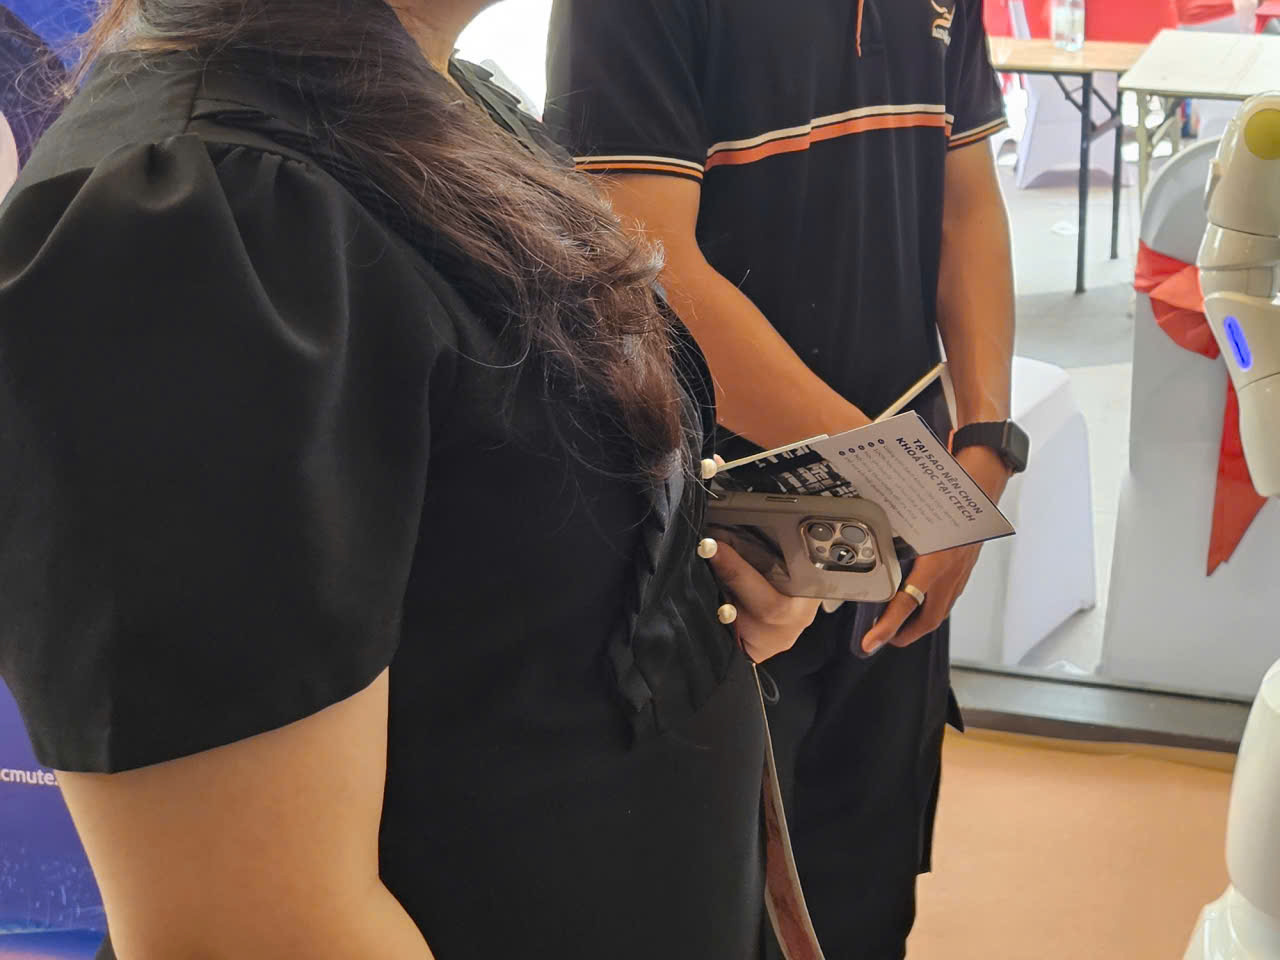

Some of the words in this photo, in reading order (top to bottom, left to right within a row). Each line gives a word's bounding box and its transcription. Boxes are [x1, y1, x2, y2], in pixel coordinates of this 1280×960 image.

[913, 438, 928, 453] TẠI
[925, 453, 944, 471] SAO
[942, 471, 961, 489] NÊN
[958, 490, 983, 514] CHỌN
[919, 462, 939, 481] HỌC
[937, 480, 951, 495] TẠI
[949, 495, 976, 522] CTECH
